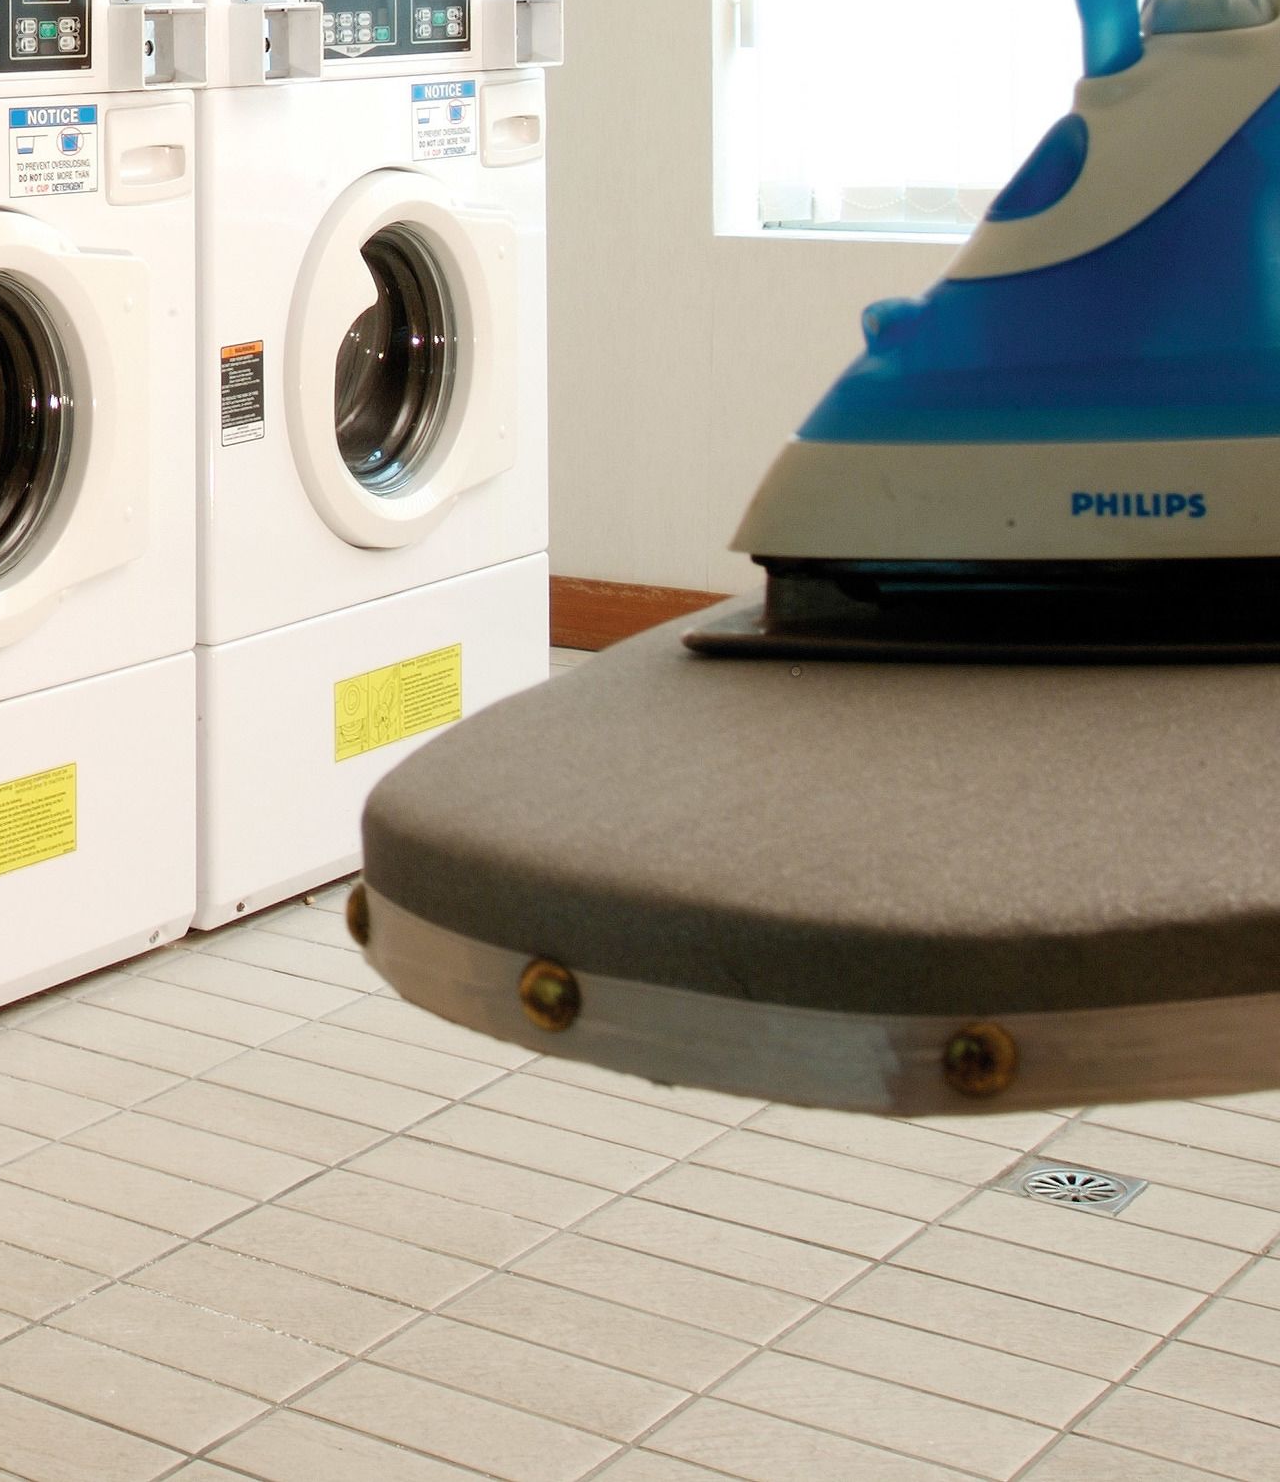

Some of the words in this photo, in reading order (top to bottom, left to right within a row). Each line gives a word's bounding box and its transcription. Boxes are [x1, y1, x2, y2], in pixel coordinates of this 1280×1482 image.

[425, 84, 462, 98] NOTICE
[27, 108, 79, 125] NOTICE
[17, 163, 24, 171] TO
[26, 161, 50, 170] PREVENT
[30, 173, 42, 181] NOT
[43, 172, 54, 180] USE
[57, 171, 72, 179] MORE
[75, 170, 89, 178] THAN
[36, 184, 49, 192] CUP
[52, 182, 84, 192] DETERGENT
[1071, 492, 1206, 518] PHILIPS
